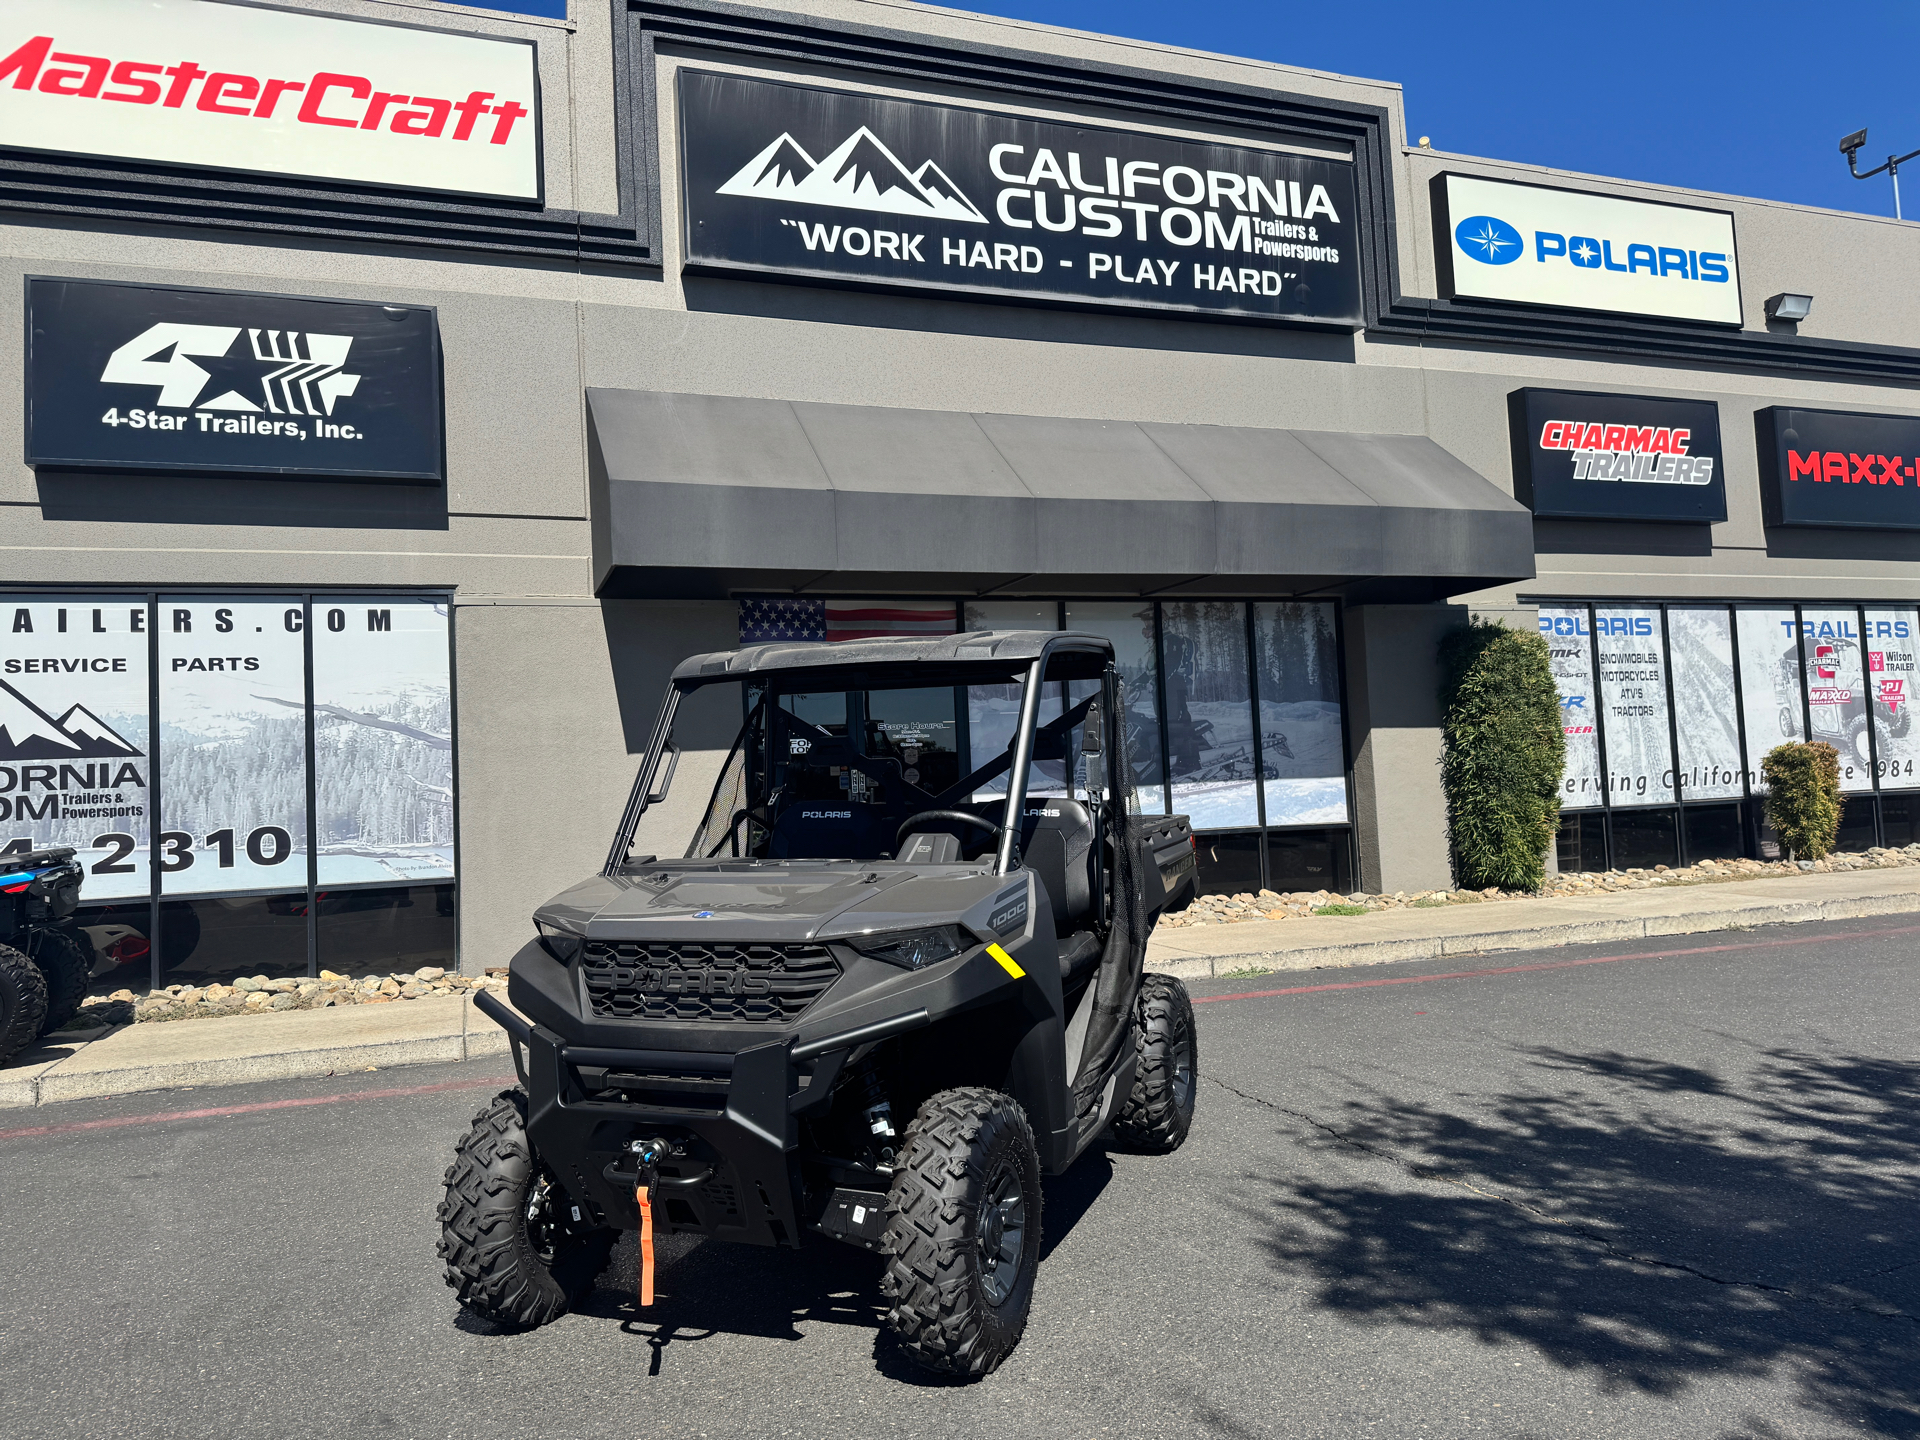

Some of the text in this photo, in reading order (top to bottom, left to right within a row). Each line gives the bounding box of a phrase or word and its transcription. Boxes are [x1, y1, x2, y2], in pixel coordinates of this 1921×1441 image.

[989, 144, 1341, 222] CALIFORNIA
[996, 188, 1252, 252] CUSTOM
[1253, 216, 1319, 240] Trailers &
[1254, 236, 1340, 264] Powersports
[1535, 231, 1729, 283] POLARIS
[943, 238, 1043, 273] HARD
[1089, 254, 1179, 287] PLAY
[102, 407, 363, 440] 4-Star Trailers, Inc.
[1540, 419, 1690, 455] CHARMAC
[1572, 451, 1713, 485] TRAILERS
[1789, 449, 1920, 486] MAXX-
[1539, 617, 1652, 636] POLARIS
[1781, 621, 1909, 638] TRAILERS
[1550, 649, 1581, 658] MK
[1600, 653, 1658, 664] SNOWMOBILES
[1886, 652, 1912, 661] Wilson
[4, 658, 127, 673] SERVICE
[172, 657, 260, 672] PARTS
[1810, 658, 1840, 666] CHARMAC
[1886, 663, 1914, 671] TRAILER
[1602, 670, 1659, 681] MOTORCYCLES
[1620, 688, 1643, 699] ATV'S
[1886, 682, 1899, 691] PJ
[1809, 690, 1851, 700] MAXXD
[1612, 706, 1653, 717] TRACTORS
[911, 722, 943, 730] Hours
[1564, 726, 1593, 734] GER
[1565, 771, 1647, 796] erving
[1662, 764, 1765, 789] Californi
[1864, 759, 1914, 779] 1984
[62, 793, 123, 805] Trailers &
[62, 806, 143, 819] Powersports
[1022, 808, 1060, 817] LARIS
[91, 826, 292, 875] 2310
[1165, 857, 1193, 882] RANGER
[993, 901, 1026, 928] 1000
[611, 968, 771, 994] POLARIS
